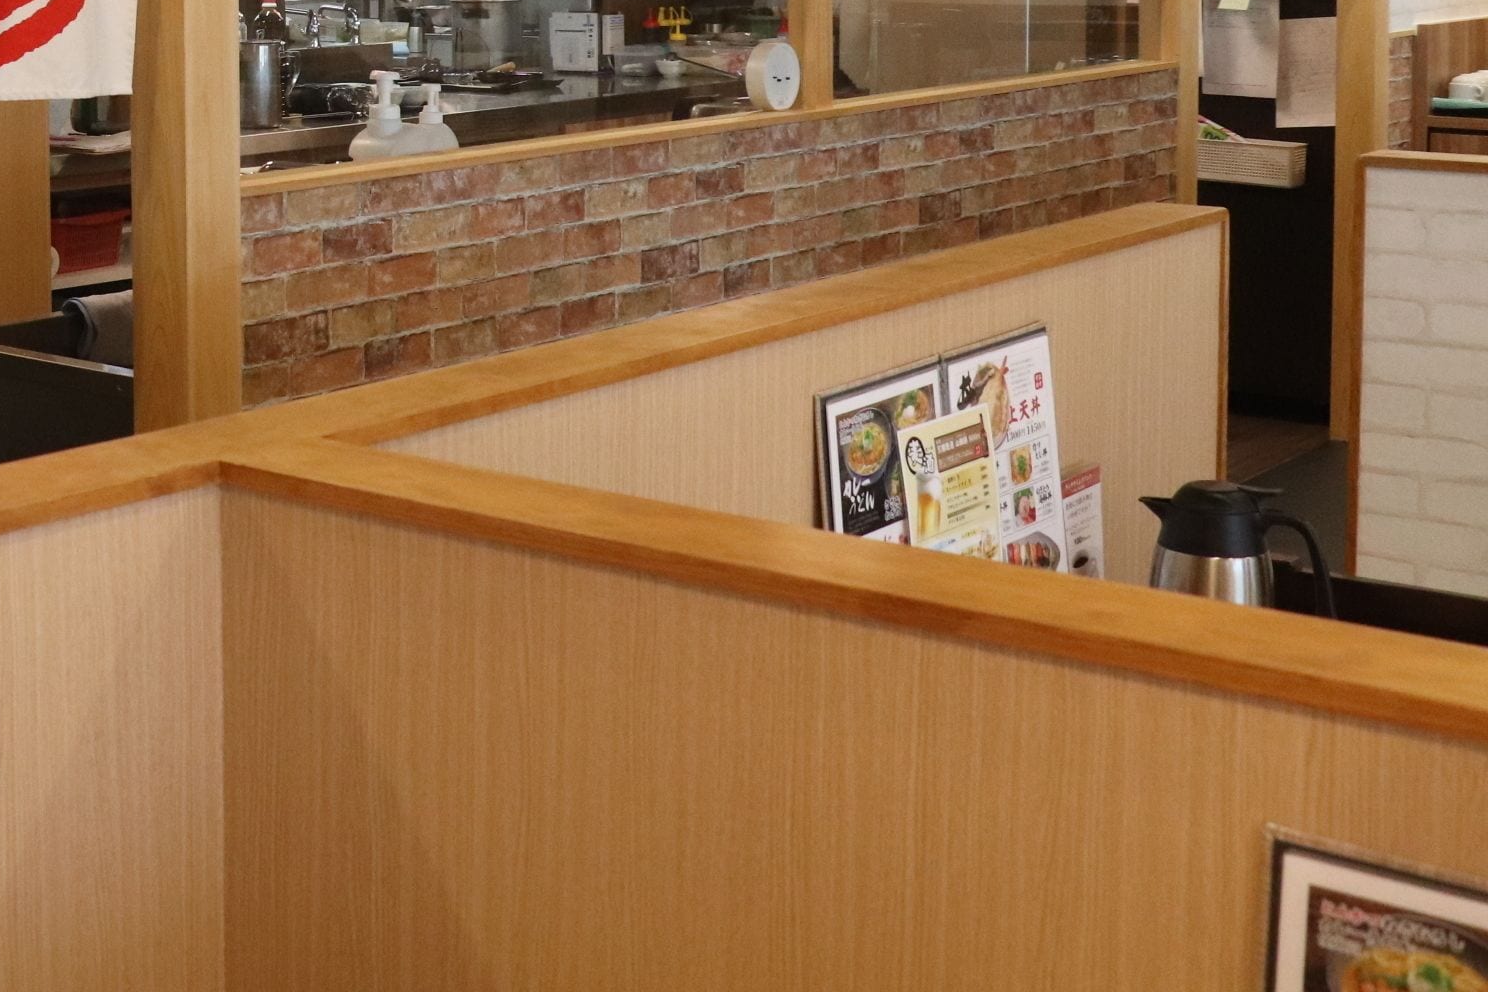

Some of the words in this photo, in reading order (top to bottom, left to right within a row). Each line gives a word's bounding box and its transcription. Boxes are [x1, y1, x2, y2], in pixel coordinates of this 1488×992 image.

[1008, 395, 1041, 425] 上天丼
[843, 476, 871, 498] カレー
[848, 491, 875, 515] うどん
